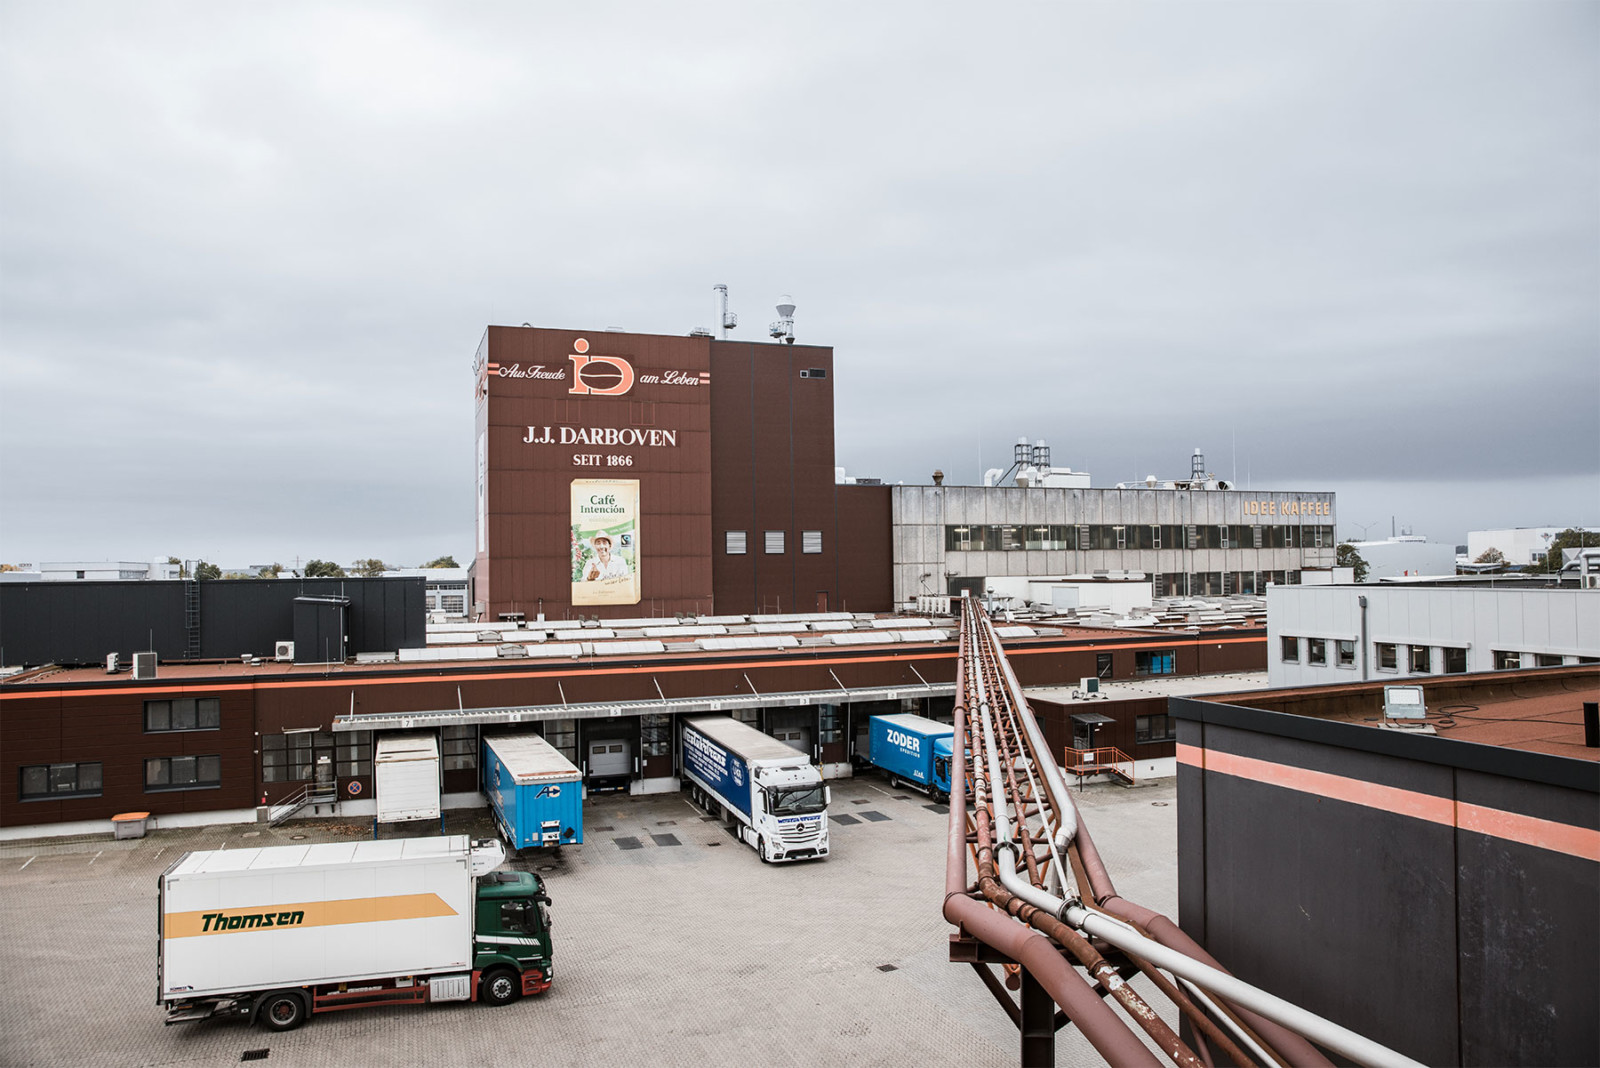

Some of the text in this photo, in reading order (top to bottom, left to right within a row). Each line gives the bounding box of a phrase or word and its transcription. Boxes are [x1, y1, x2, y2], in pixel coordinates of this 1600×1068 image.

[499, 363, 566, 380] Aus Freude
[639, 370, 700, 386] am Leben
[523, 426, 677, 447] J.J. DARBOVEN
[573, 454, 633, 467] SEIT 1866
[590, 494, 615, 505] Café
[580, 504, 625, 514] Intención
[1244, 500, 1330, 516] IDEE KAFFEE
[887, 728, 920, 752] ZODER
[202, 911, 305, 932] Thomsen
